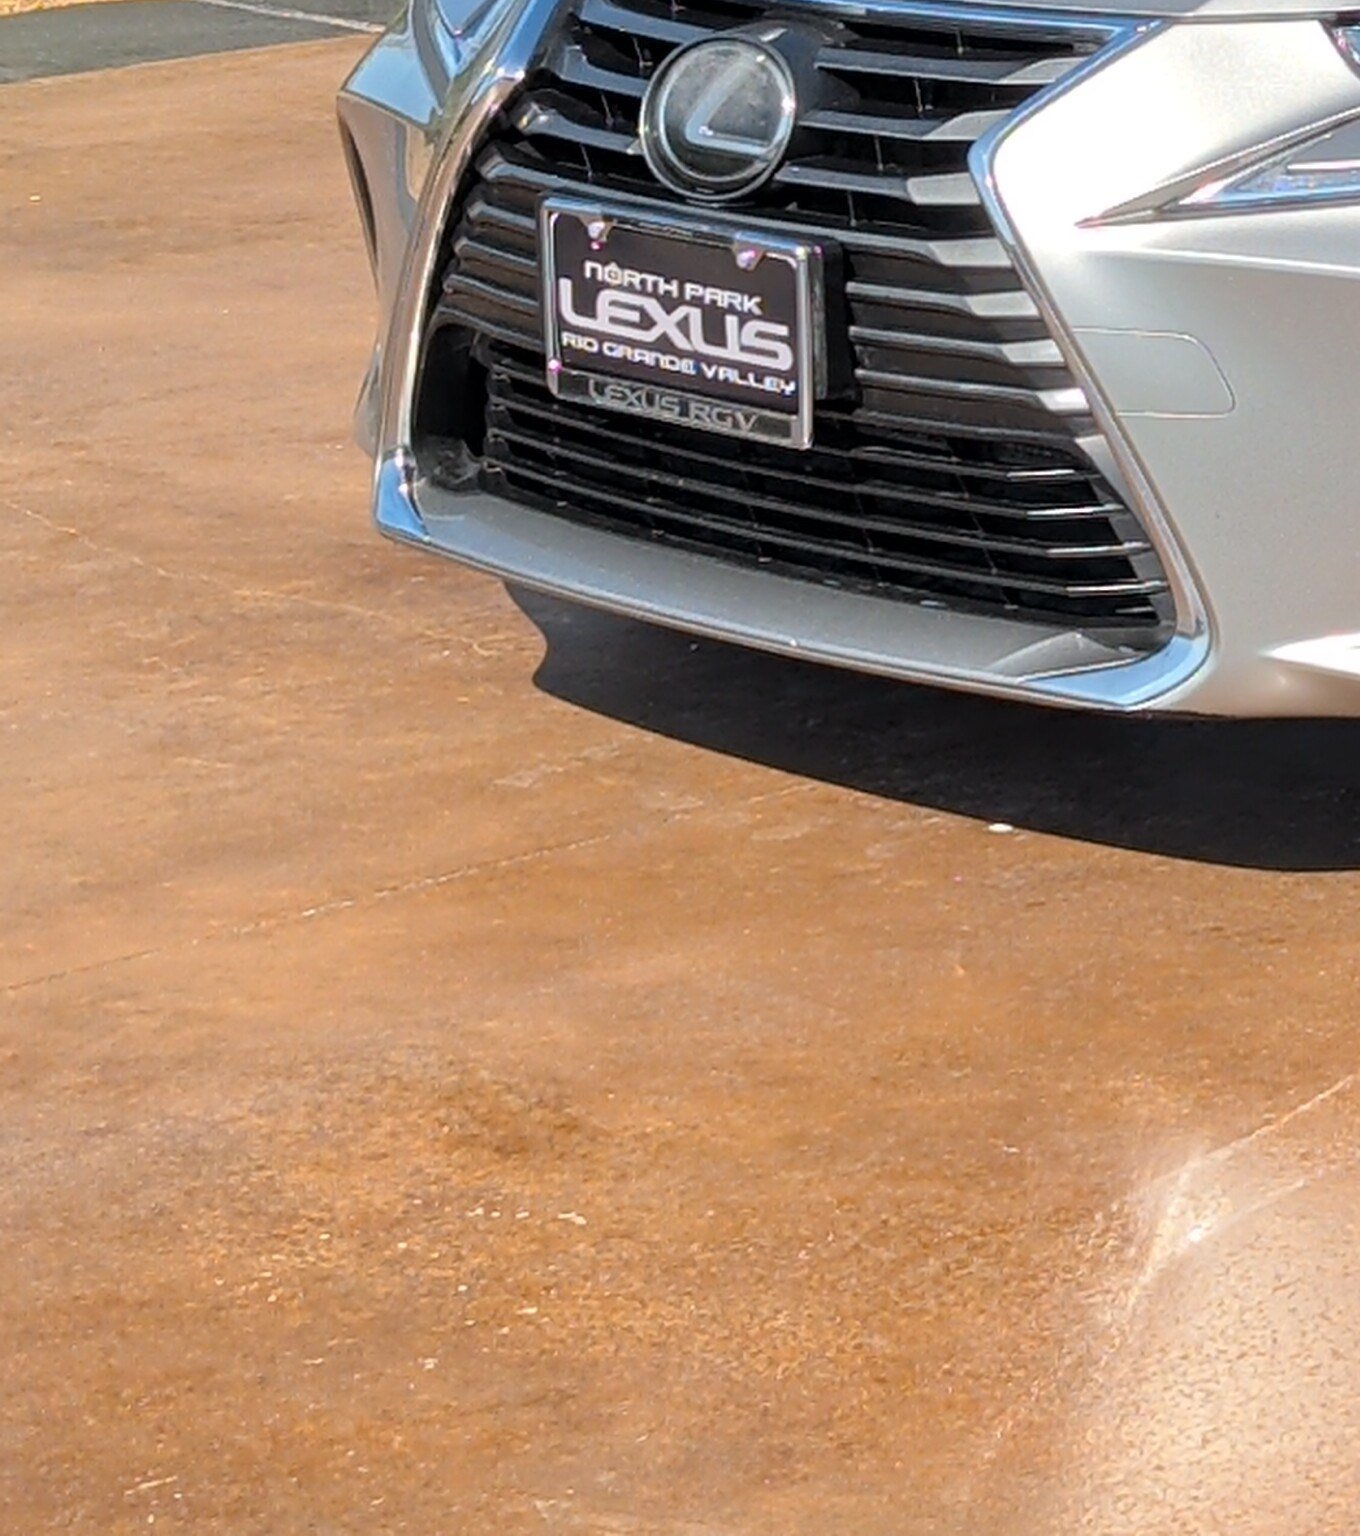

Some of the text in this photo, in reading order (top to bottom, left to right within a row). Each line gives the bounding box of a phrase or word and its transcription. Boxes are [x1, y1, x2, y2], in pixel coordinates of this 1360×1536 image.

[584, 260, 763, 315] NORTH PARK
[559, 276, 795, 371] LEXUS
[561, 330, 797, 396] RIO GRANDE VALLEY
[589, 378, 759, 433] LEXUS RGV
